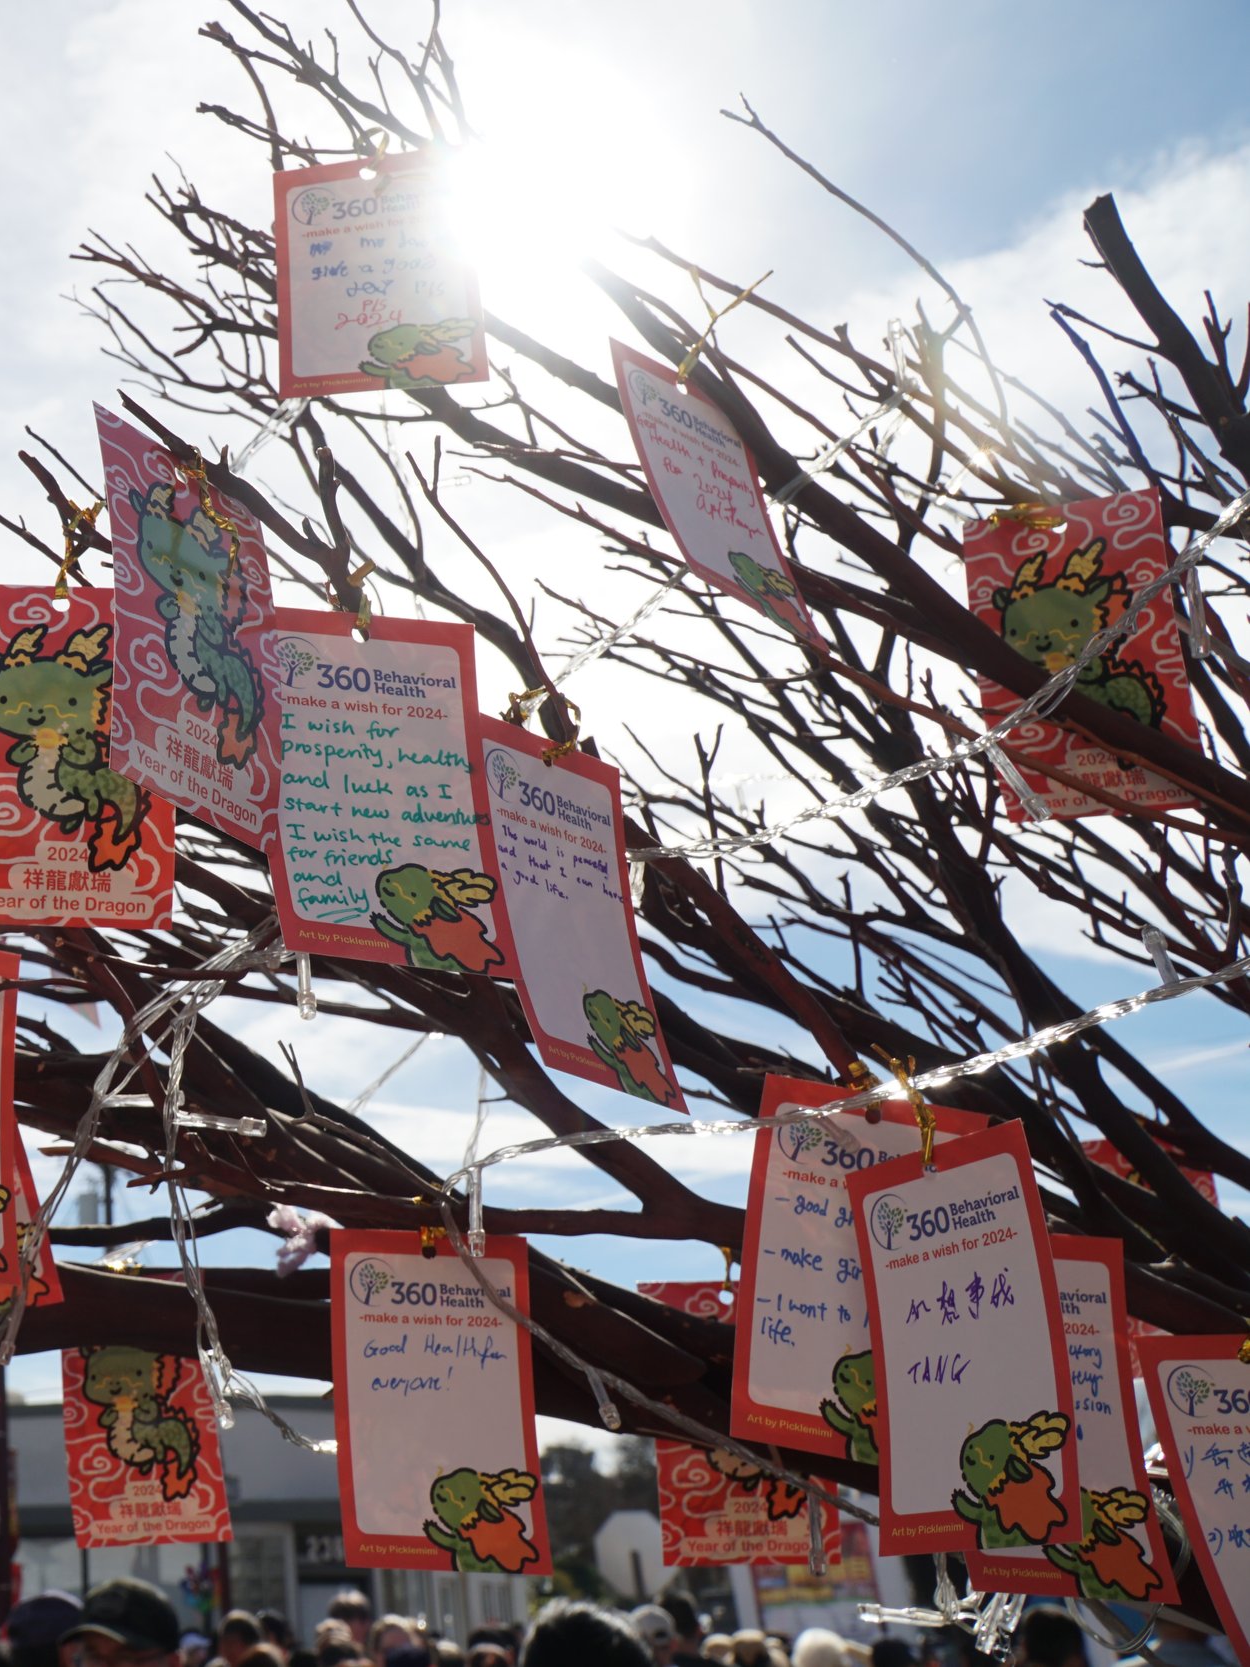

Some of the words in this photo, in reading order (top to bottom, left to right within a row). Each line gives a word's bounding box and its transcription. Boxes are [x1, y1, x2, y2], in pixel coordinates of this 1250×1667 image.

[332, 198, 378, 220] 360
[316, 664, 371, 693] 360
[373, 669, 456, 689] Behavioral
[374, 682, 426, 699] Health
[281, 713, 296, 729] I
[308, 719, 355, 736] wish
[366, 720, 399, 740] for
[164, 734, 235, 793] 祥龍獻瑞
[282, 770, 330, 789] and
[344, 774, 393, 795] luck
[406, 784, 428, 798] as
[438, 784, 452, 799] I
[284, 798, 343, 816] start
[351, 805, 389, 819] new
[518, 780, 555, 816] 360
[556, 795, 611, 827] Behavioral
[558, 808, 592, 832] Health
[286, 823, 306, 841] I
[313, 829, 365, 843] wish
[368, 832, 402, 848] the
[412, 835, 470, 852] same
[46, 846, 89, 863] 2024
[287, 846, 317, 862] for
[324, 849, 393, 866] friends
[498, 844, 517, 858] and
[528, 855, 550, 870] that
[556, 846, 564, 858] is
[23, 869, 112, 893] 祥龍獻瑞
[293, 871, 342, 886] and
[501, 862, 508, 870] a
[513, 870, 539, 885] good
[29, 895, 48, 910] of
[52, 896, 81, 912] the
[84, 896, 146, 917] Dragon
[297, 886, 370, 913] family
[794, 1195, 829, 1217] good
[906, 1206, 950, 1242] 360
[949, 1185, 1020, 1216] Behavioral
[951, 1209, 997, 1231] Health
[439, 1296, 485, 1308] Health
[837, 1305, 851, 1323] to
[761, 1317, 795, 1347] life.
[1064, 1322, 1100, 1336] 2024-
[363, 1334, 408, 1359] Good
[907, 1353, 971, 1385] TANG
[747, 1414, 763, 1426] Art
[765, 1417, 778, 1430] by
[779, 1419, 833, 1438] Picklemimi
[1187, 1423, 1231, 1435] -make
[1233, 1424, 1244, 1435] a
[96, 1524, 123, 1534] Year
[127, 1523, 138, 1532] of
[142, 1522, 161, 1531] the
[165, 1520, 210, 1532] Dragon
[891, 1525, 906, 1537] Art
[906, 1524, 917, 1537] by
[917, 1522, 965, 1535] Picklemimi
[359, 1543, 374, 1554] Art
[375, 1544, 388, 1555] by
[388, 1545, 439, 1556] Picklemimi
[688, 1540, 719, 1552] Year
[723, 1542, 735, 1552] of
[742, 1540, 763, 1551] the
[767, 1540, 809, 1552] Drago
[982, 1565, 995, 1577] Art
[996, 1567, 1009, 1579] by
